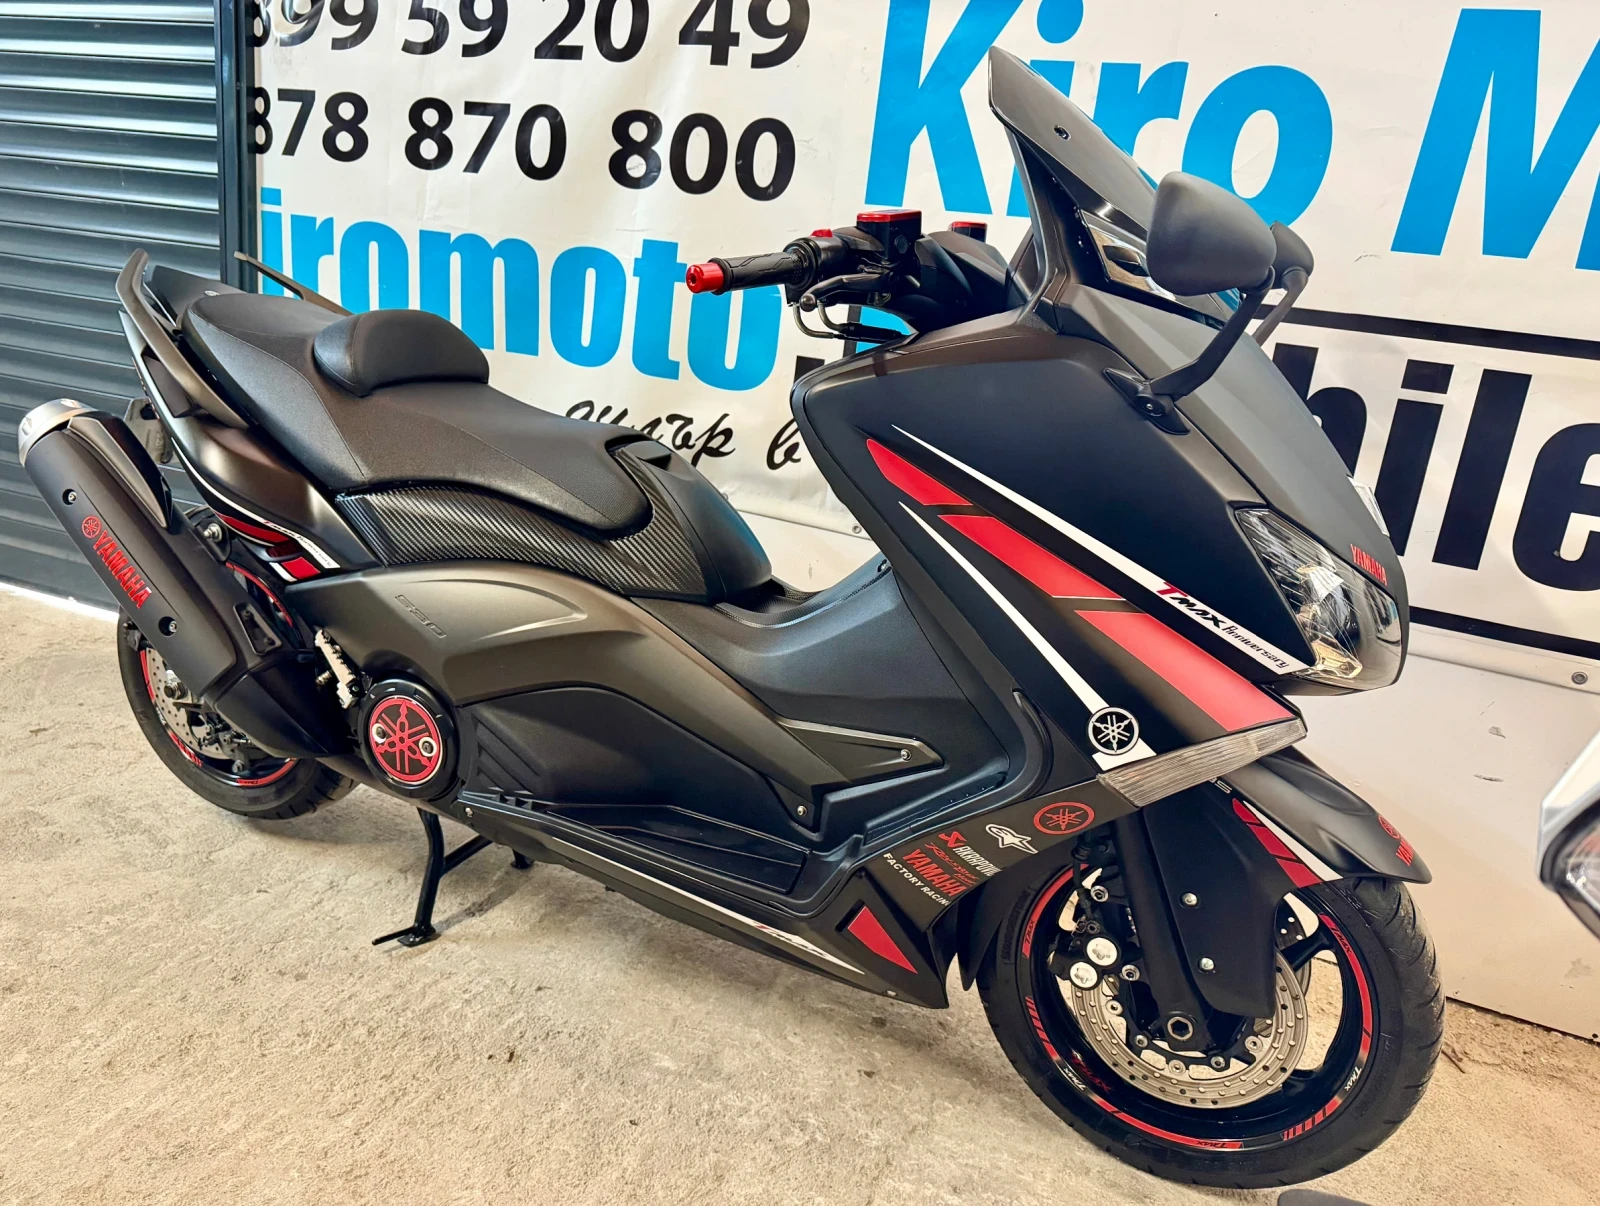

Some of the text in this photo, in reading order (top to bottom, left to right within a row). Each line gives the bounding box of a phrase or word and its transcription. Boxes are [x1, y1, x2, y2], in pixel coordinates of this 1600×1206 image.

[402, 0, 508, 57] 59
[534, 0, 650, 63] 20
[678, 0, 810, 69] 49
[404, 97, 567, 181] 870
[608, 109, 796, 202] 800
[92, 529, 152, 609] YAMAHA
[1350, 543, 1388, 588] YAMAHA
[1156, 581, 1226, 629] TMAX
[883, 852, 922, 888] FACTORY
[902, 849, 967, 897] YAMAHA
